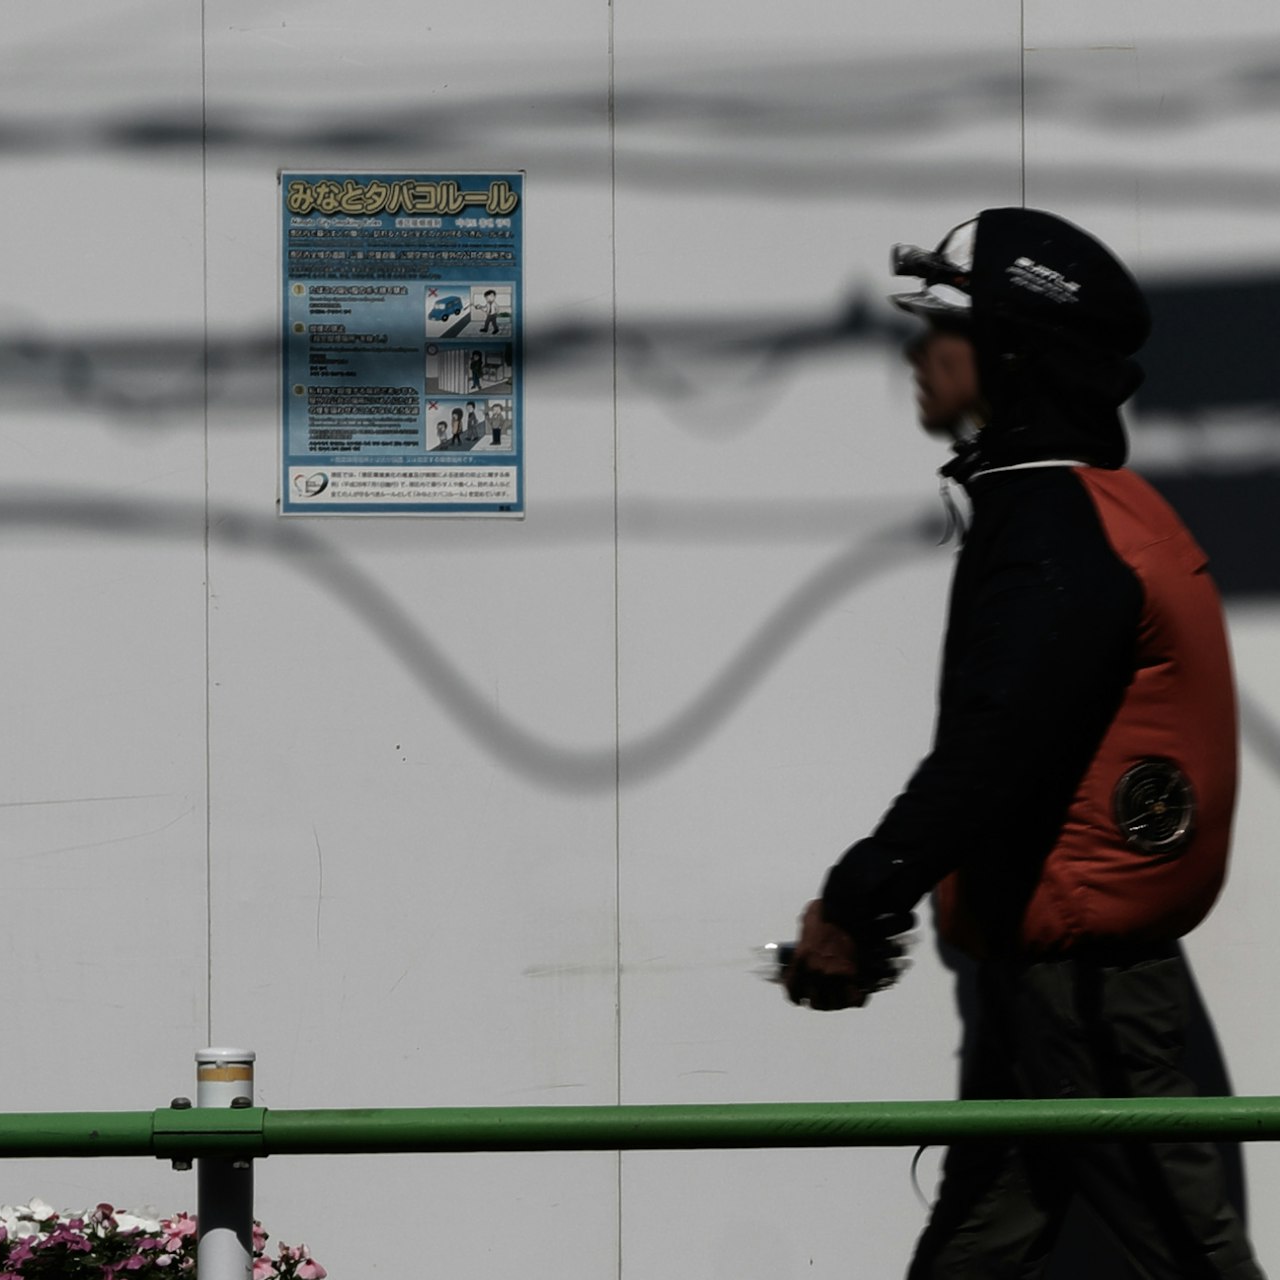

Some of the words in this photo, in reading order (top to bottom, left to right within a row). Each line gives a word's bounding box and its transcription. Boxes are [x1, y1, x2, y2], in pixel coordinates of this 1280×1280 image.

[287, 180, 518, 214] みなとタバコルール
